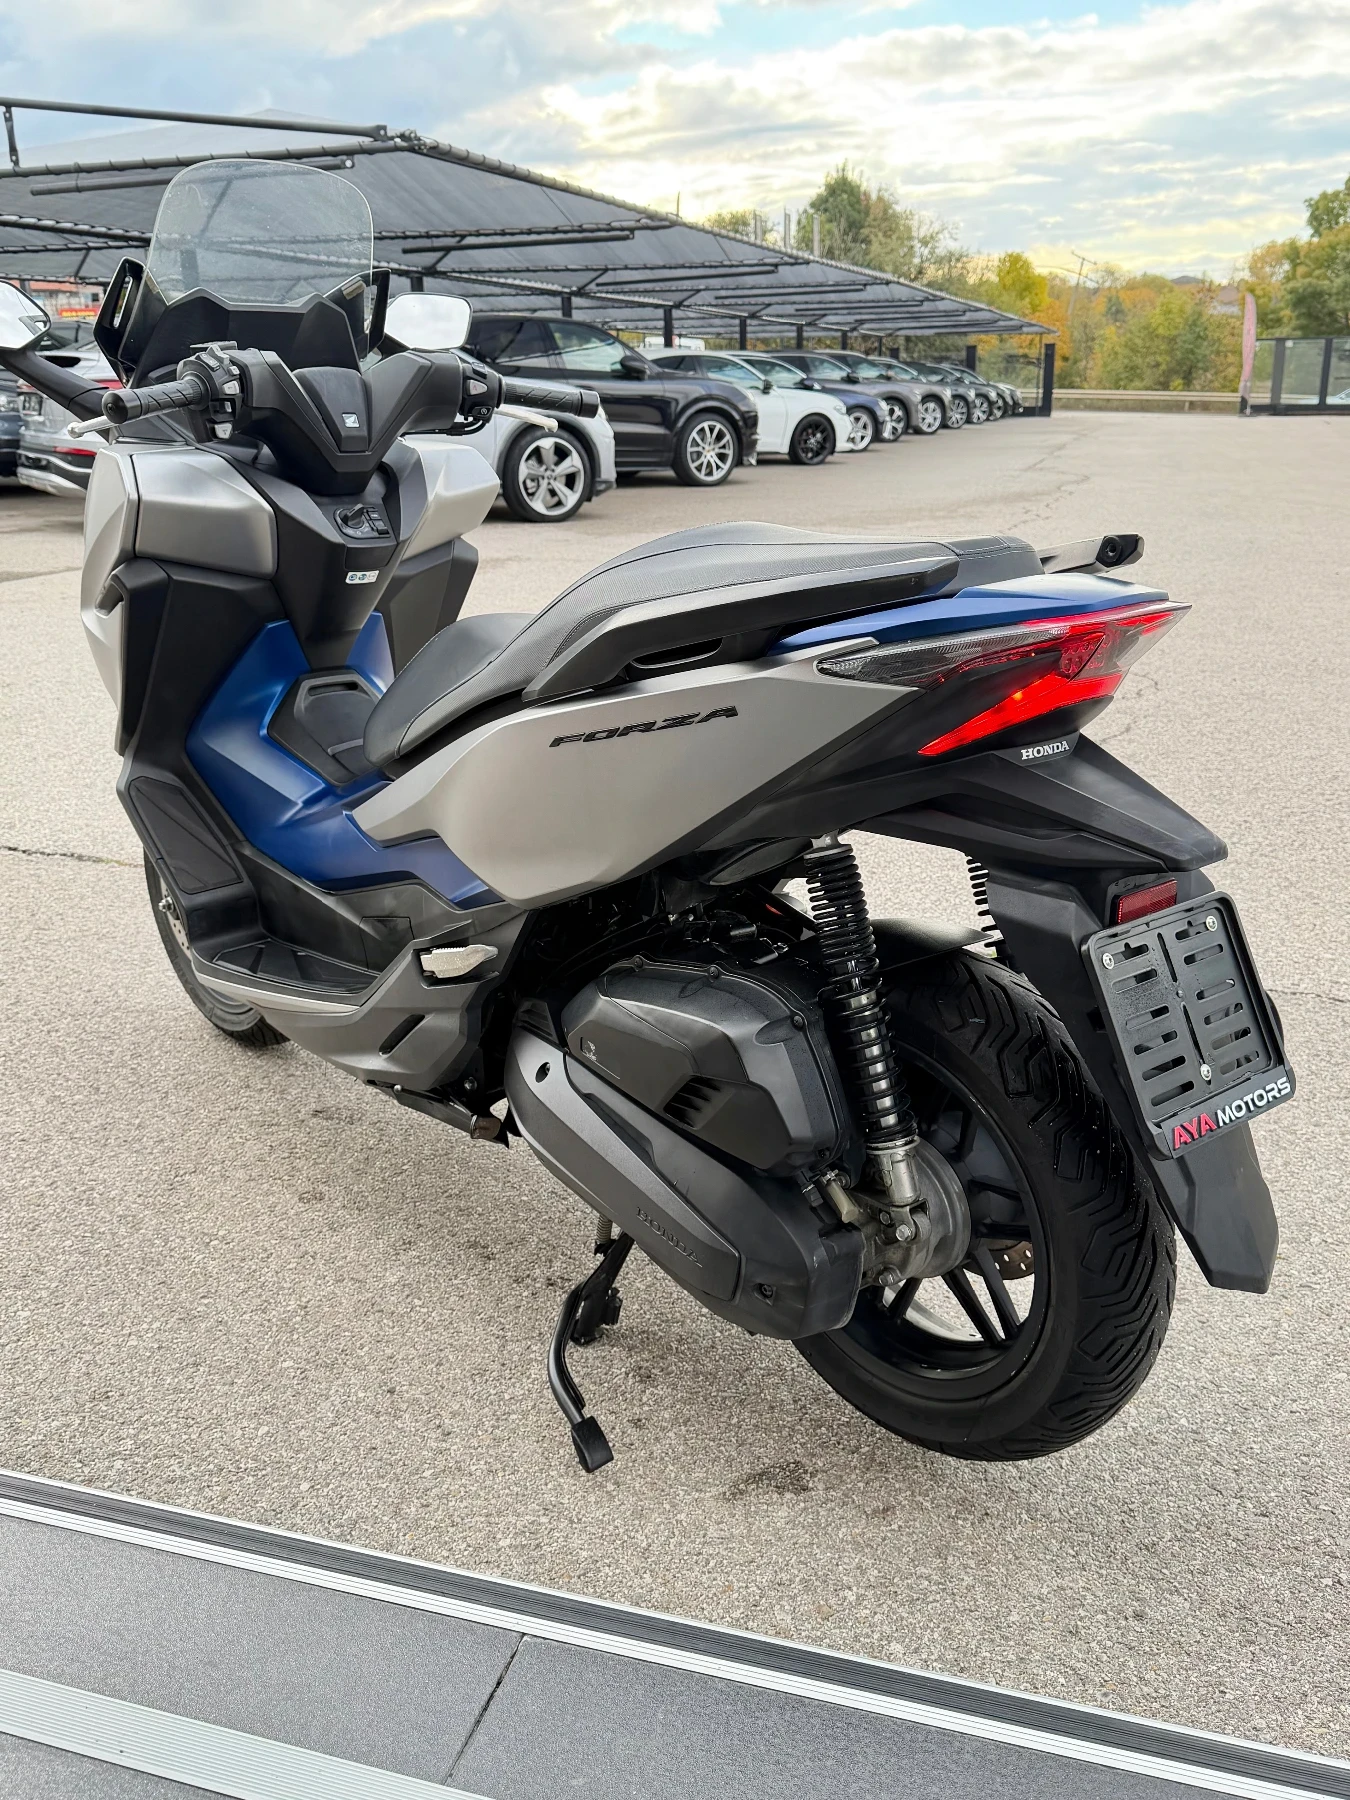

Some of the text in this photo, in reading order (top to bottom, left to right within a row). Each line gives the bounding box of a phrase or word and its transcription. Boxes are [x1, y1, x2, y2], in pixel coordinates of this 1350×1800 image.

[548, 704, 739, 747] FORZA
[1020, 740, 1070, 761] HONDA
[1173, 1076, 1291, 1150] AYA MOTORS
[636, 1206, 703, 1268] HONDA
